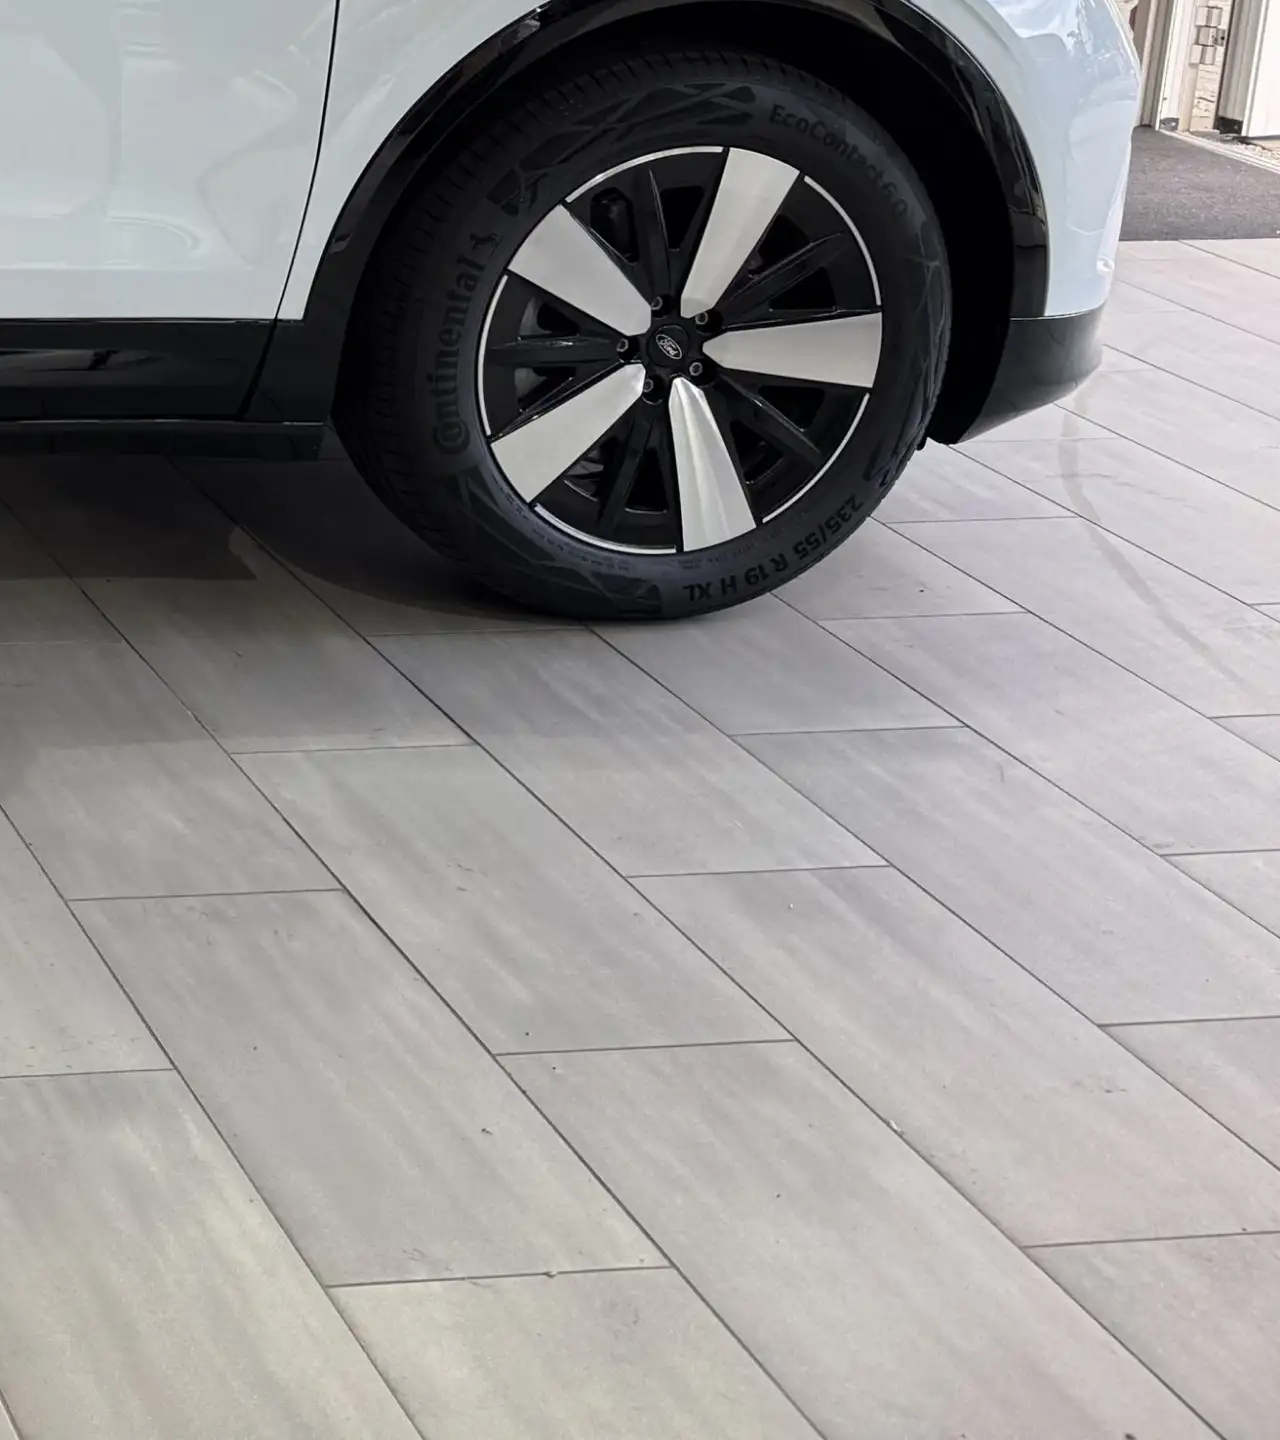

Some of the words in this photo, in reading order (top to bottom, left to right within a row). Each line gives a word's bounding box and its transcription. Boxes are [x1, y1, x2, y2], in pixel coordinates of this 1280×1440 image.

[425, 253, 486, 455] Continental
[793, 493, 864, 559] 235/55
[682, 583, 713, 602] XL
[720, 575, 738, 595] H
